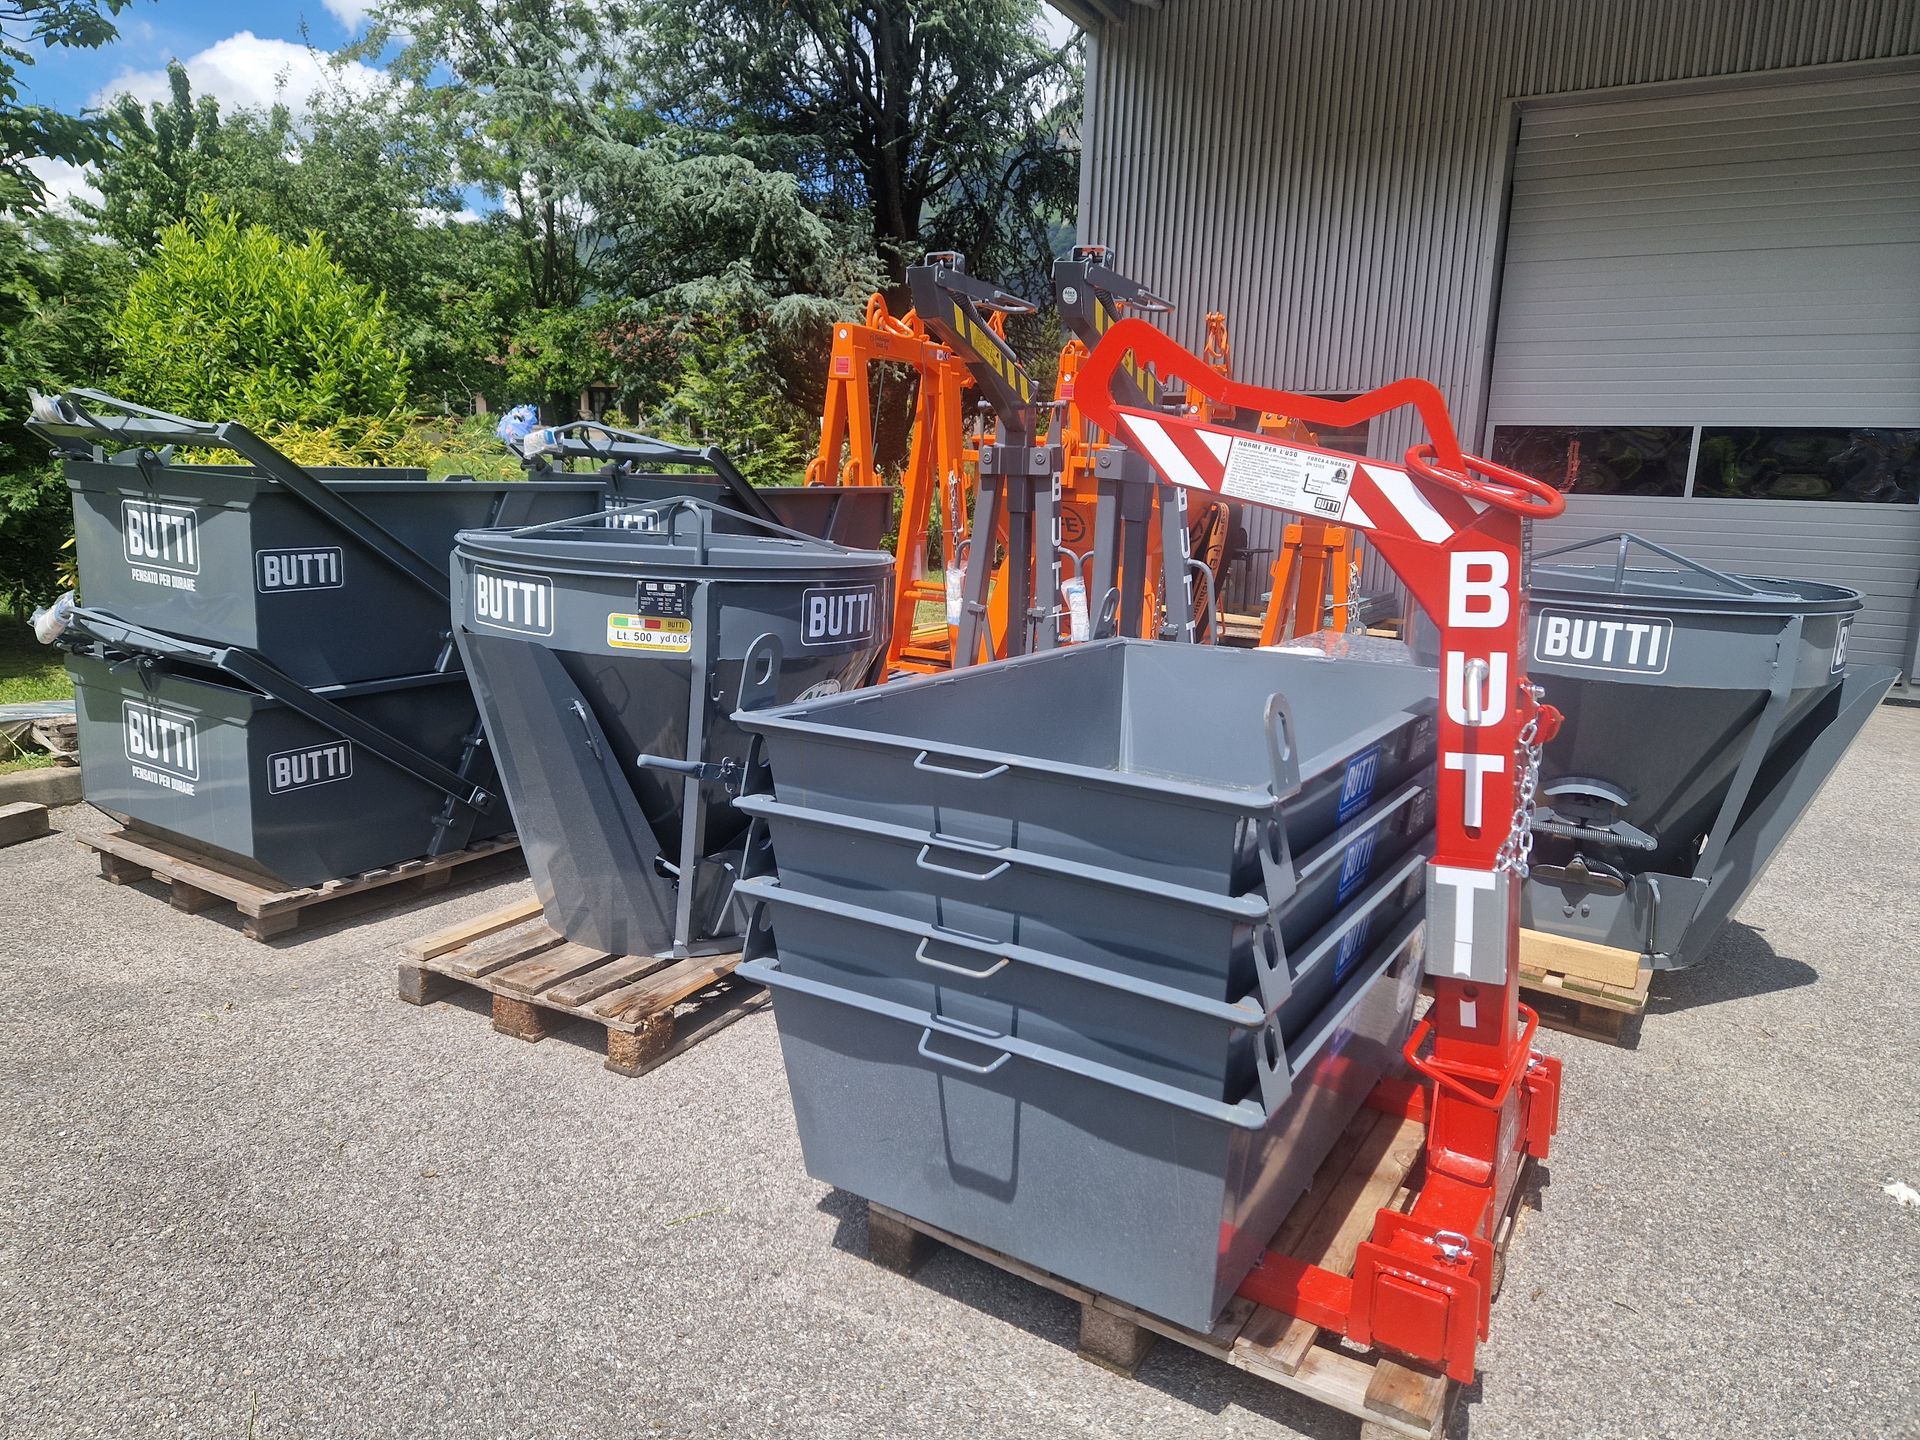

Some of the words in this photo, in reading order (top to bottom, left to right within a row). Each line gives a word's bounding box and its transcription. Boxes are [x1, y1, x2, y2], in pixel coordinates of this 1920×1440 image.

[1238, 441, 1261, 450] NORME
[1280, 449, 1298, 458] L'USO
[1315, 498, 1340, 512] BUTTI
[127, 509, 194, 565] BUTTI
[1052, 471, 1062, 633] BUTT
[131, 568, 159, 585] PENSATO
[159, 573, 171, 587] PER
[263, 552, 337, 588] BUTTI
[1177, 487, 1196, 644] BUTT
[475, 574, 547, 628] BUTTI
[808, 592, 874, 638] BUTTI
[616, 630, 629, 641] Lt.
[634, 632, 652, 642] 500
[660, 634, 671, 644] yd
[672, 635, 688, 644] 0,65
[667, 621, 684, 629] BUTTI
[1544, 615, 1662, 666] BUTTI
[128, 710, 194, 771] BUTTI
[131, 765, 158, 784] PENSATO
[159, 773, 171, 788] PER
[274, 745, 346, 788] BUTTI
[1343, 753, 1378, 803] BUTTI
[1343, 830, 1376, 883] BUTTI
